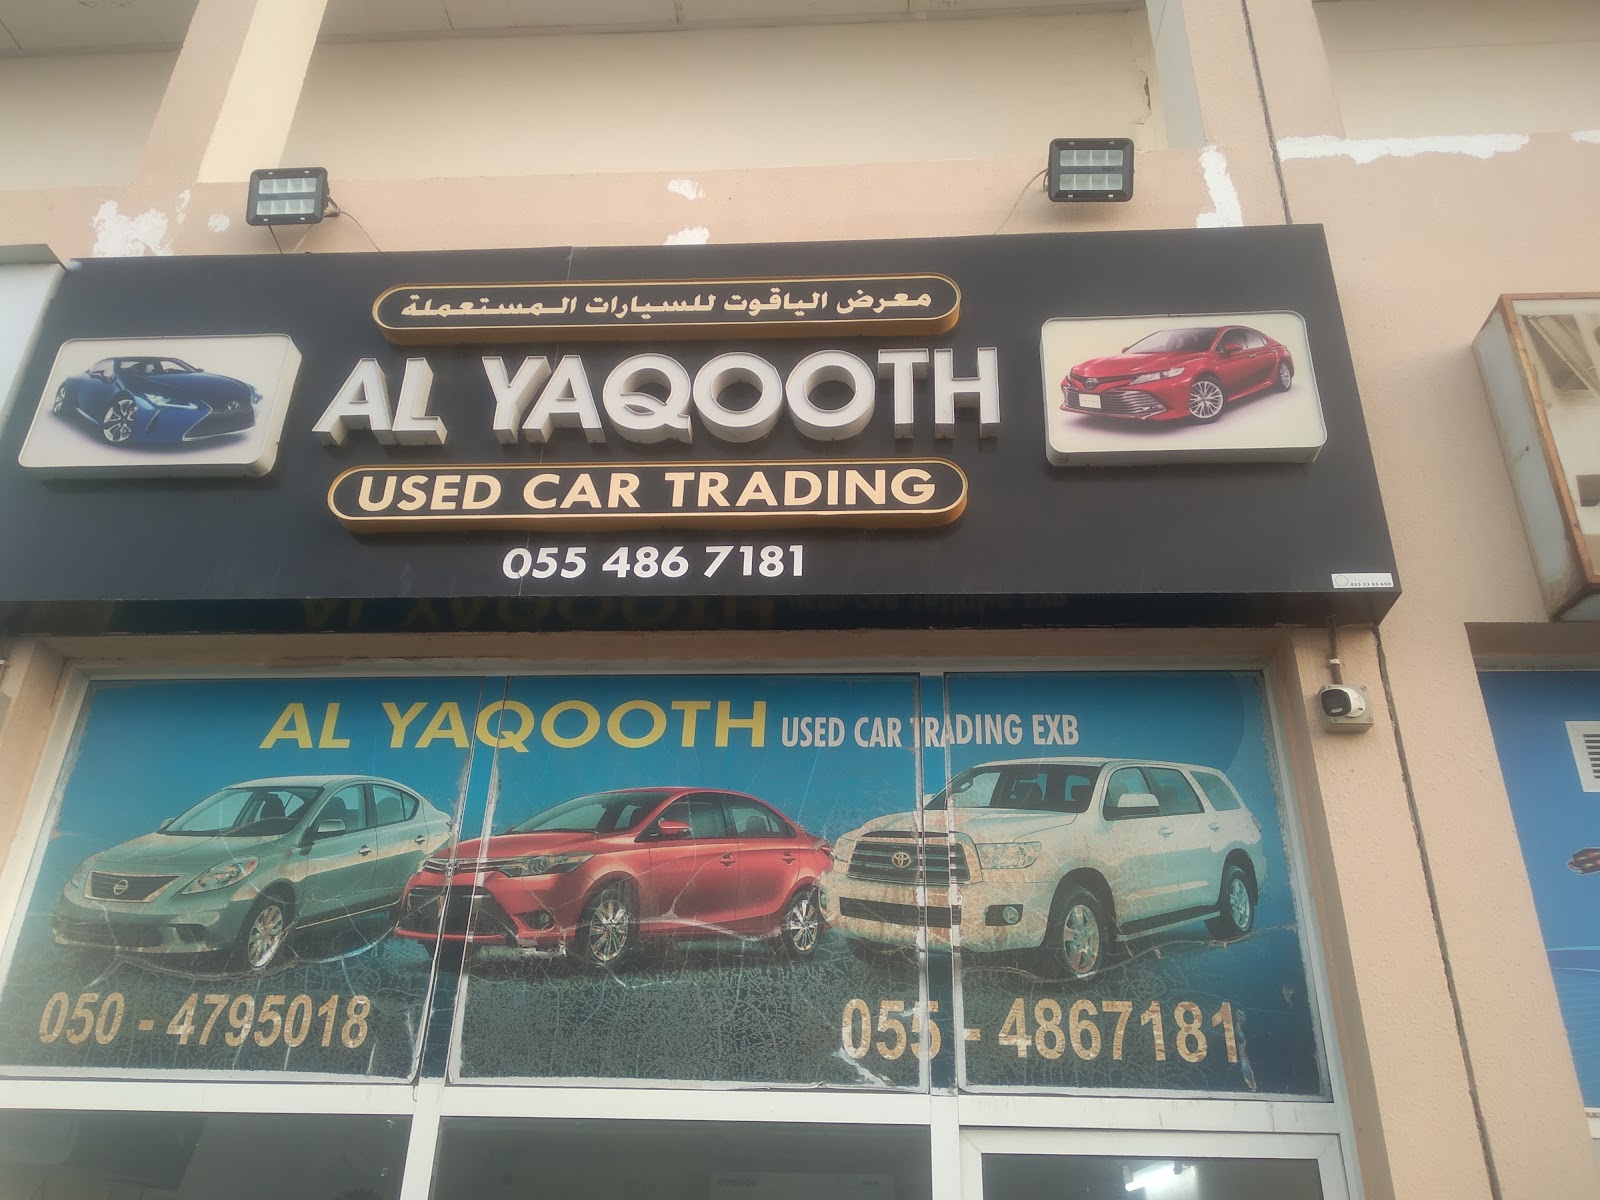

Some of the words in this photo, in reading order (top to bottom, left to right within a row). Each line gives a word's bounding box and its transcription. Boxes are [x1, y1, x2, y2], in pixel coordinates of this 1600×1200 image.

[585, 293, 717, 320] للسيارات
[723, 287, 829, 317] الياقوت
[836, 289, 932, 314] معرض
[311, 357, 447, 443] AL
[482, 347, 1000, 443] YAQOOTH
[358, 474, 502, 511] USED
[523, 473, 641, 509] CAR
[664, 468, 936, 507] TRADING
[502, 547, 586, 579] 055
[602, 546, 689, 578] 486
[703, 545, 803, 577] 7181
[259, 702, 351, 748] AL
[380, 700, 767, 753] YAQOOTH
[782, 717, 845, 748] USED
[854, 717, 902, 748] CAR
[910, 714, 1023, 748] TRADING
[1032, 714, 1080, 745] EXB
[39, 992, 125, 1044] 050
[166, 993, 371, 1048] 4795018
[841, 998, 942, 1060] 055
[998, 997, 1238, 1063] 4867181
